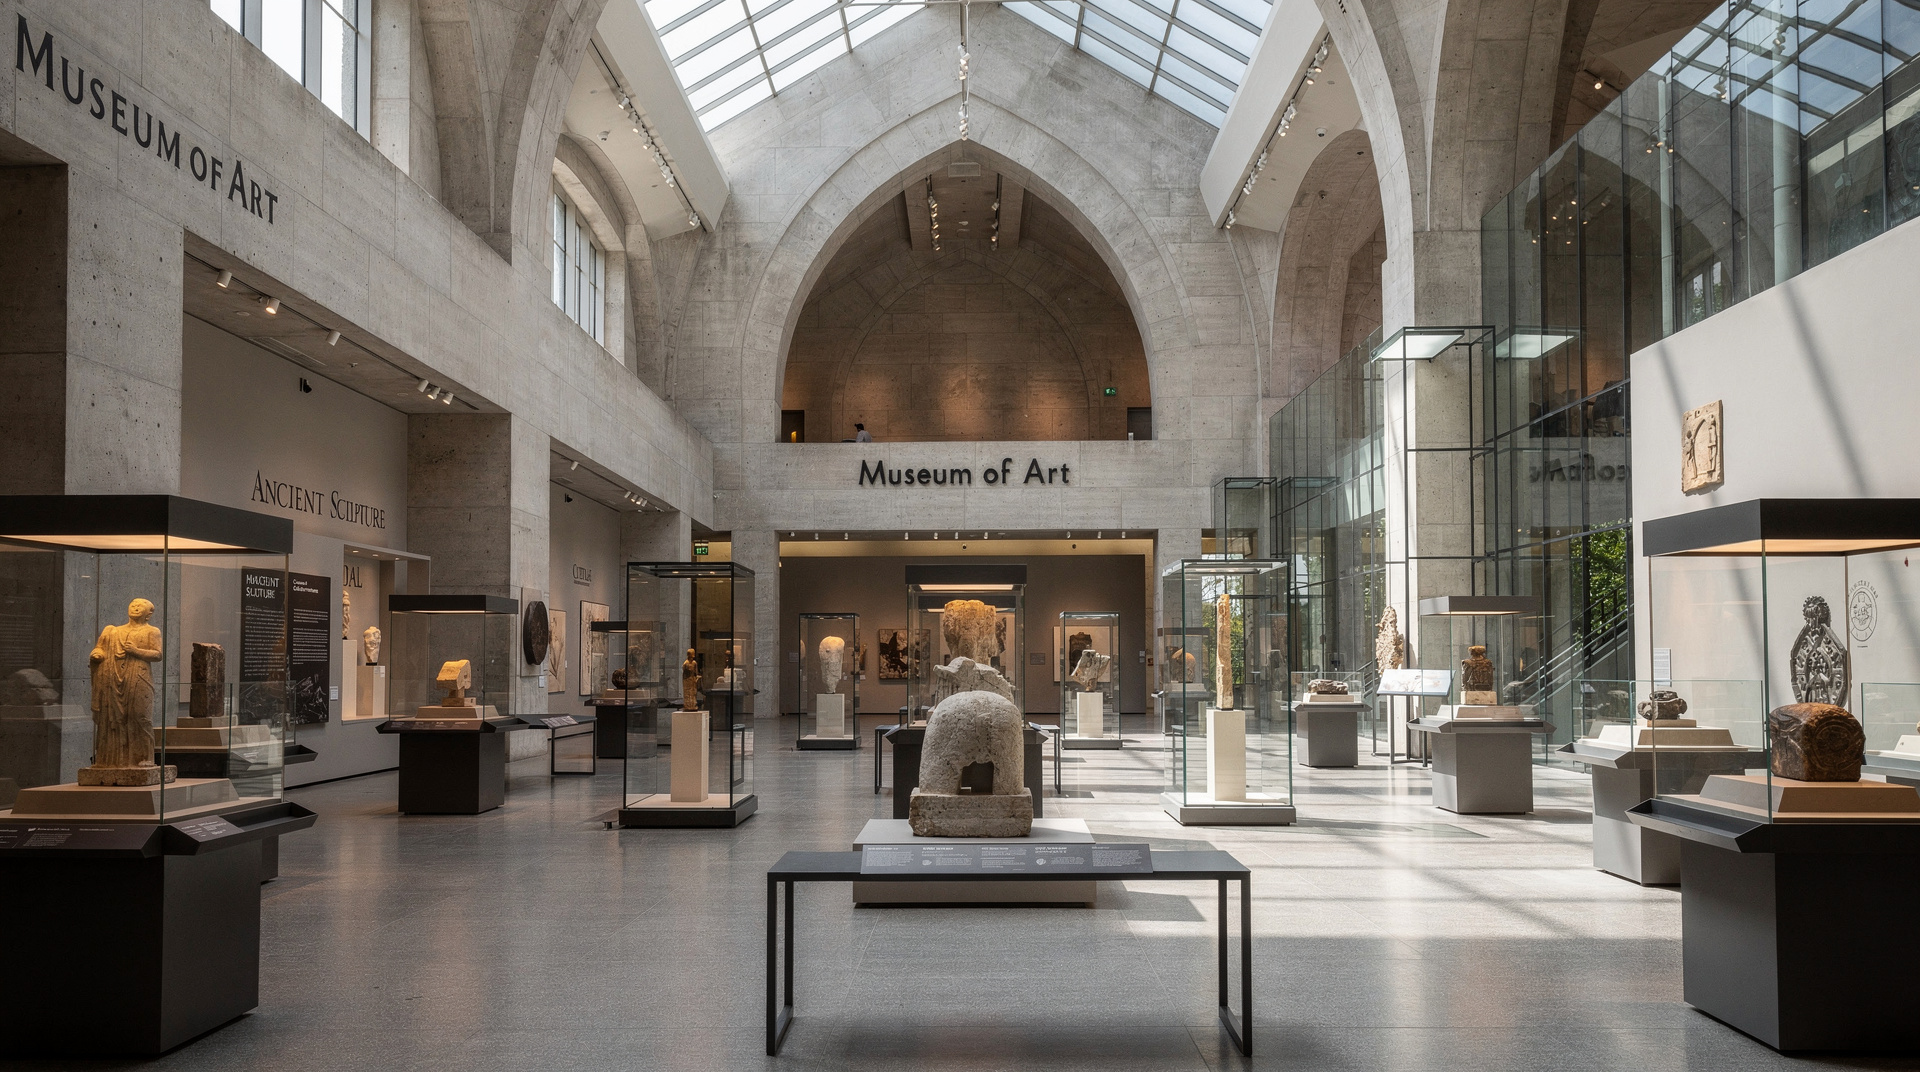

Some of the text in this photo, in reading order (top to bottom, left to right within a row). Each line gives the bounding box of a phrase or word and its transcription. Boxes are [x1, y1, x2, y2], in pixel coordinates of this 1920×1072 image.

[16, 12, 278, 225] MUSEUM OF ART
[251, 469, 325, 516] ANCIENT
[858, 457, 1070, 485] Museum of Art
